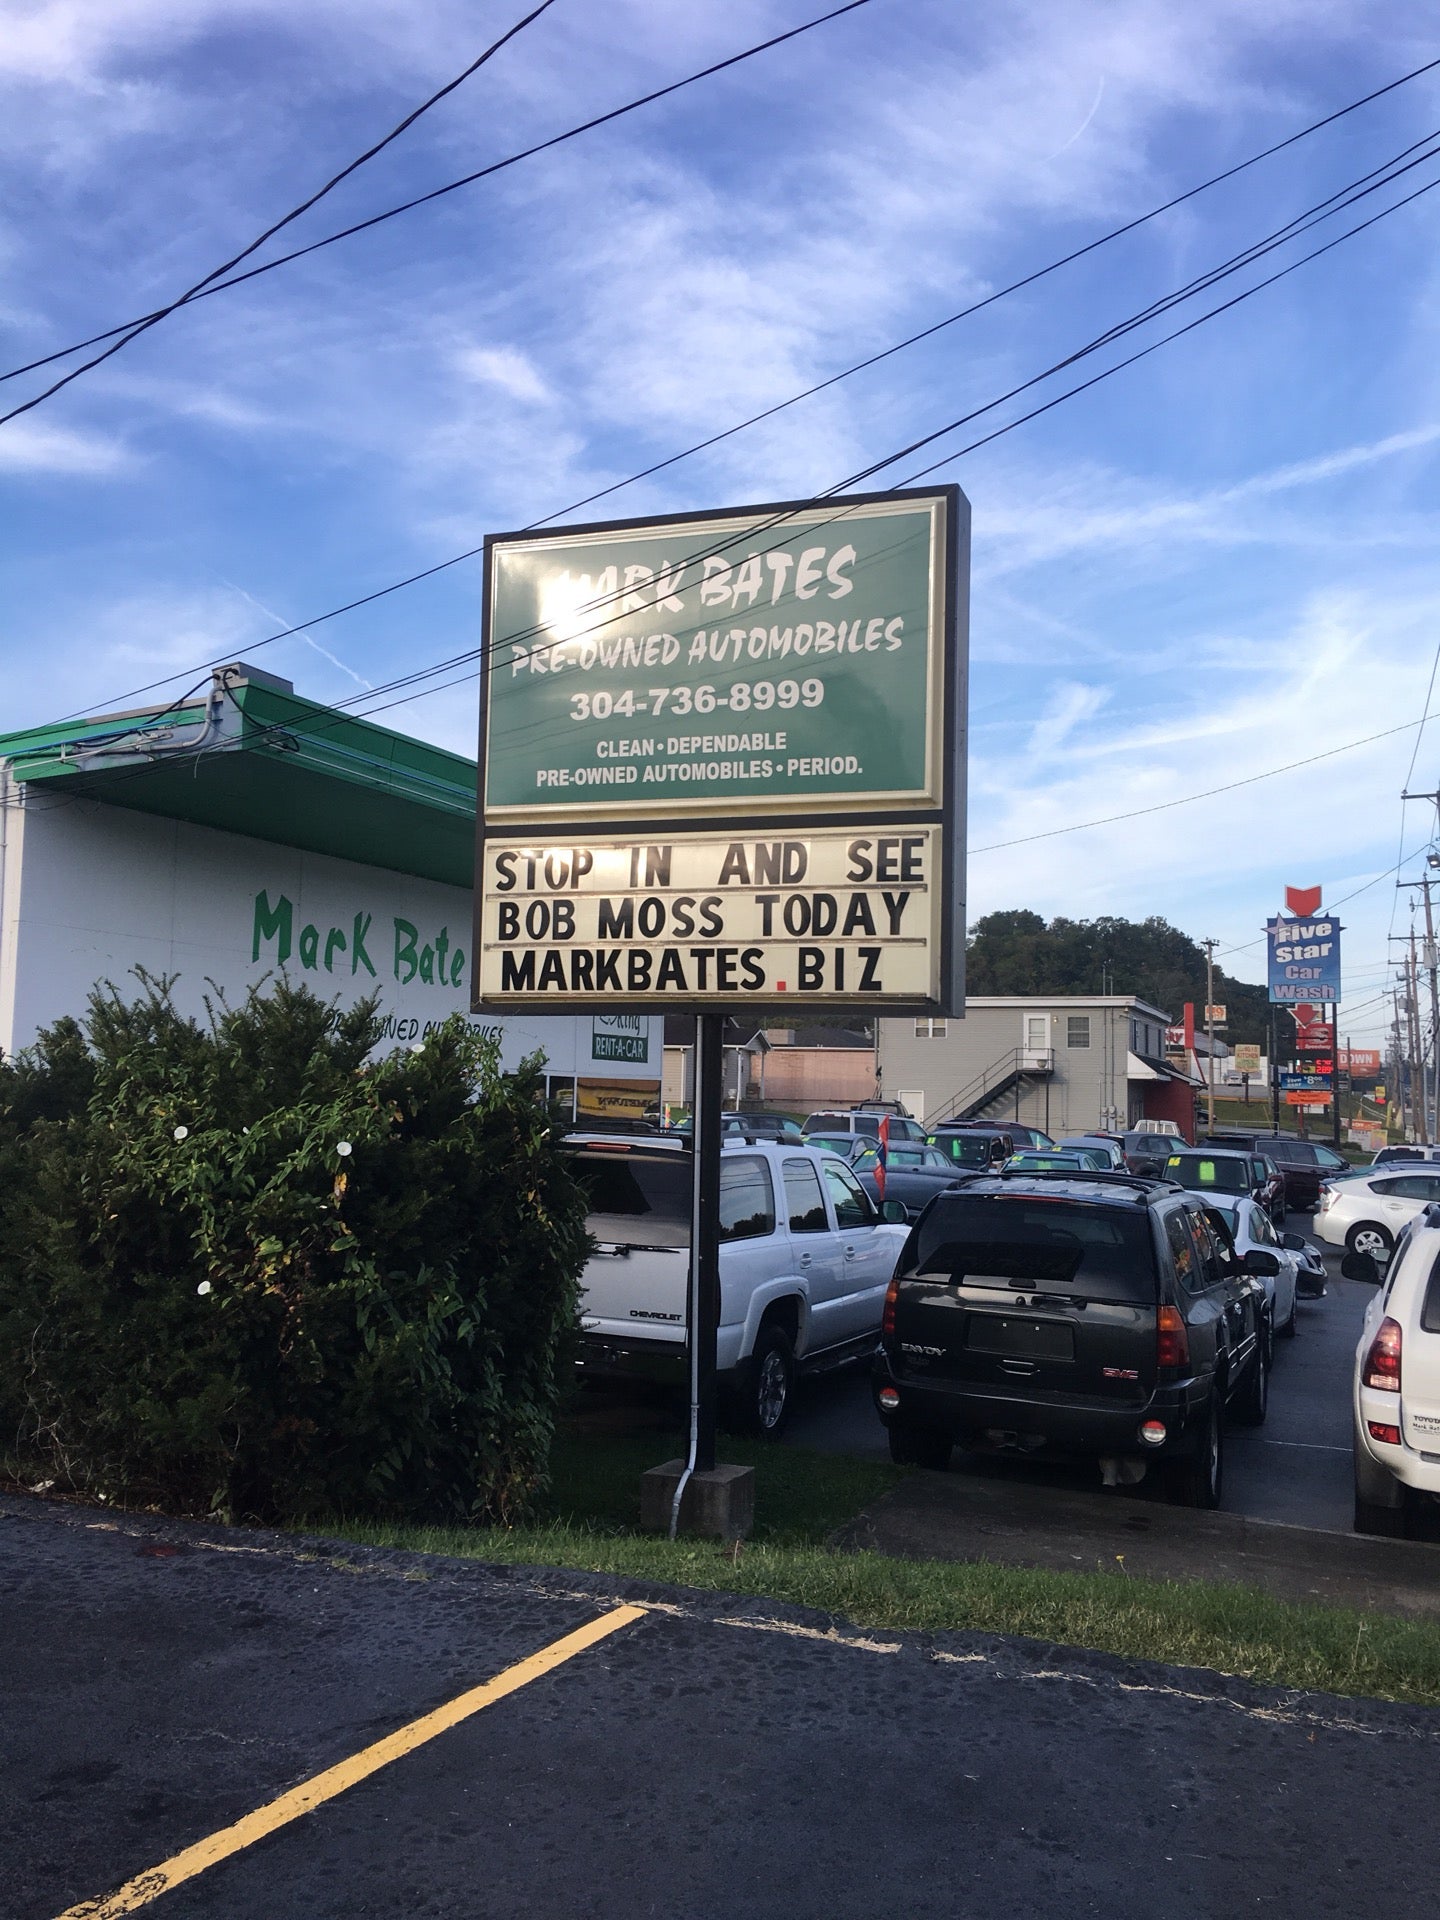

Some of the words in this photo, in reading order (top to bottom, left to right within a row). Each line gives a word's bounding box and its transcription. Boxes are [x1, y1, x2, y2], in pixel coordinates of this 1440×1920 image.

[699, 544, 857, 609] BATES
[511, 632, 681, 678] PRE-OWNED
[687, 616, 905, 666] AUTOMOBILES
[569, 677, 825, 721] 304-736-8999
[596, 738, 655, 759] CLEAN
[666, 731, 787, 756] DEPENDABLE
[536, 765, 638, 788] PRE-OWNED
[642, 758, 774, 783] AUTOMOBILES
[786, 755, 864, 777] PERIOD.
[495, 849, 594, 891] STOP
[629, 845, 672, 888] IN
[717, 841, 809, 886] AND
[846, 838, 925, 883] SEE
[498, 898, 576, 941] BOB
[600, 896, 724, 939] MOSS
[755, 891, 911, 937] TODAY
[1278, 921, 1333, 944] Five
[1275, 941, 1333, 964] Star
[1285, 965, 1323, 981] Car
[1273, 983, 1336, 1000] Wash
[629, 1309, 683, 1321] CHEVROLET
[901, 1342, 947, 1356] ENVOY
[1102, 1367, 1139, 1380] GMC
